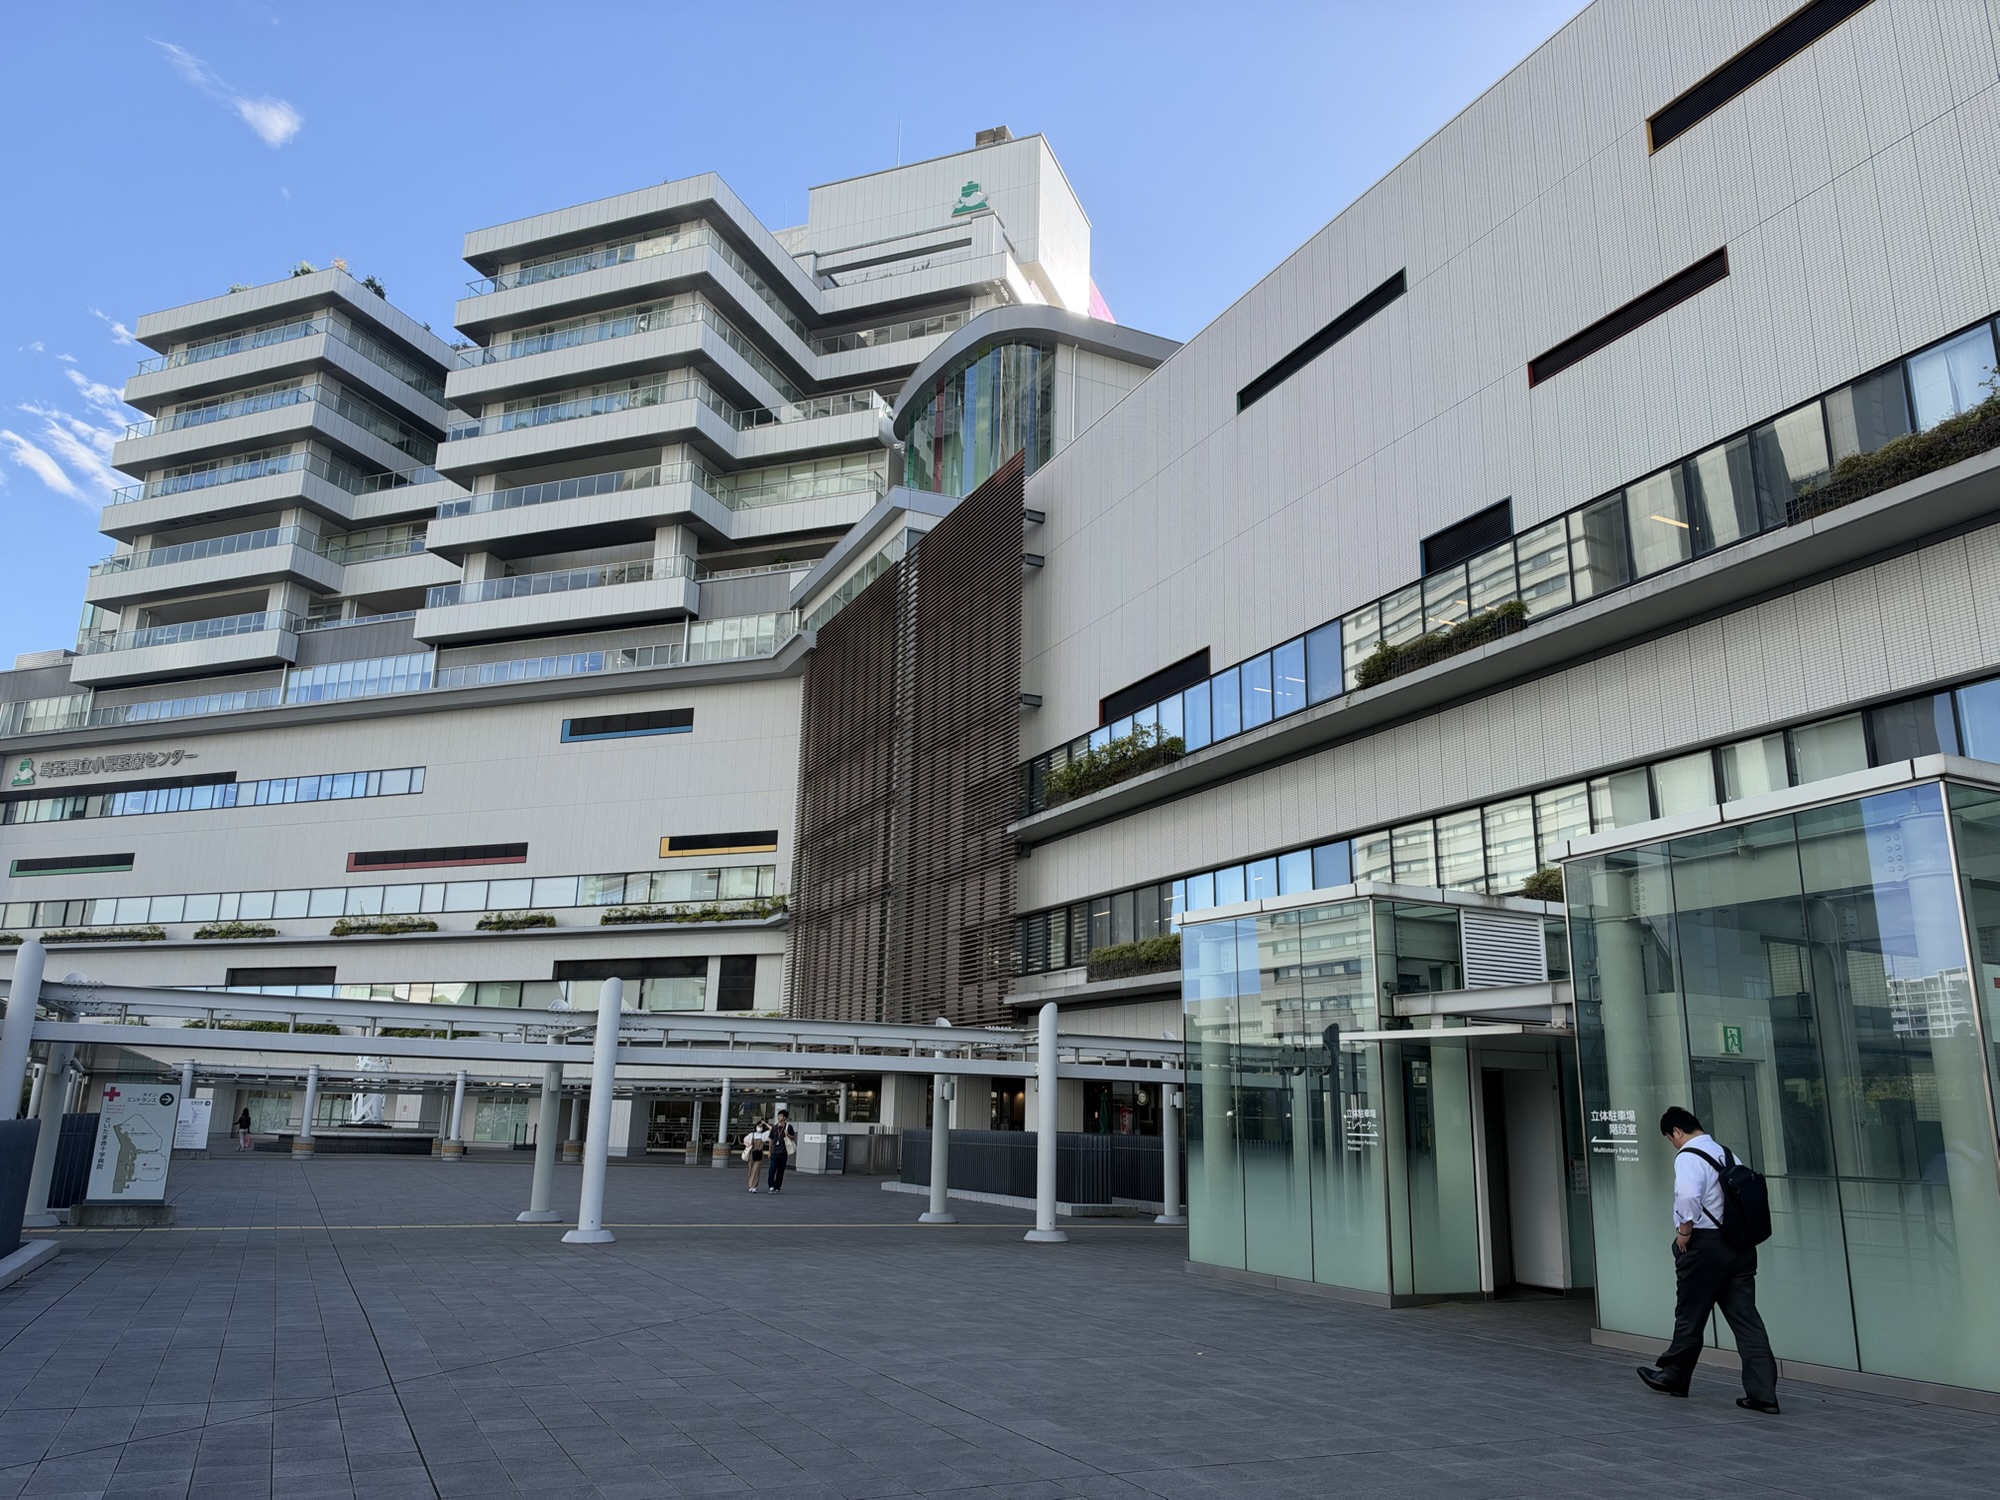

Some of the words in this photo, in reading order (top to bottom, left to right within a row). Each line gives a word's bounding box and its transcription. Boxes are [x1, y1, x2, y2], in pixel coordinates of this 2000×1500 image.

[39, 749, 198, 778] 埼玉県立小児医療センター
[1346, 1109, 1376, 1119] 立体駐車場
[1591, 1110, 1636, 1122] 立体駐車場
[1347, 1121, 1377, 1130] エレベーター
[1609, 1124, 1637, 1135] 階段室
[96, 1117, 111, 1170] さいたま赤十字病院
[1618, 1147, 1638, 1155] Parking
